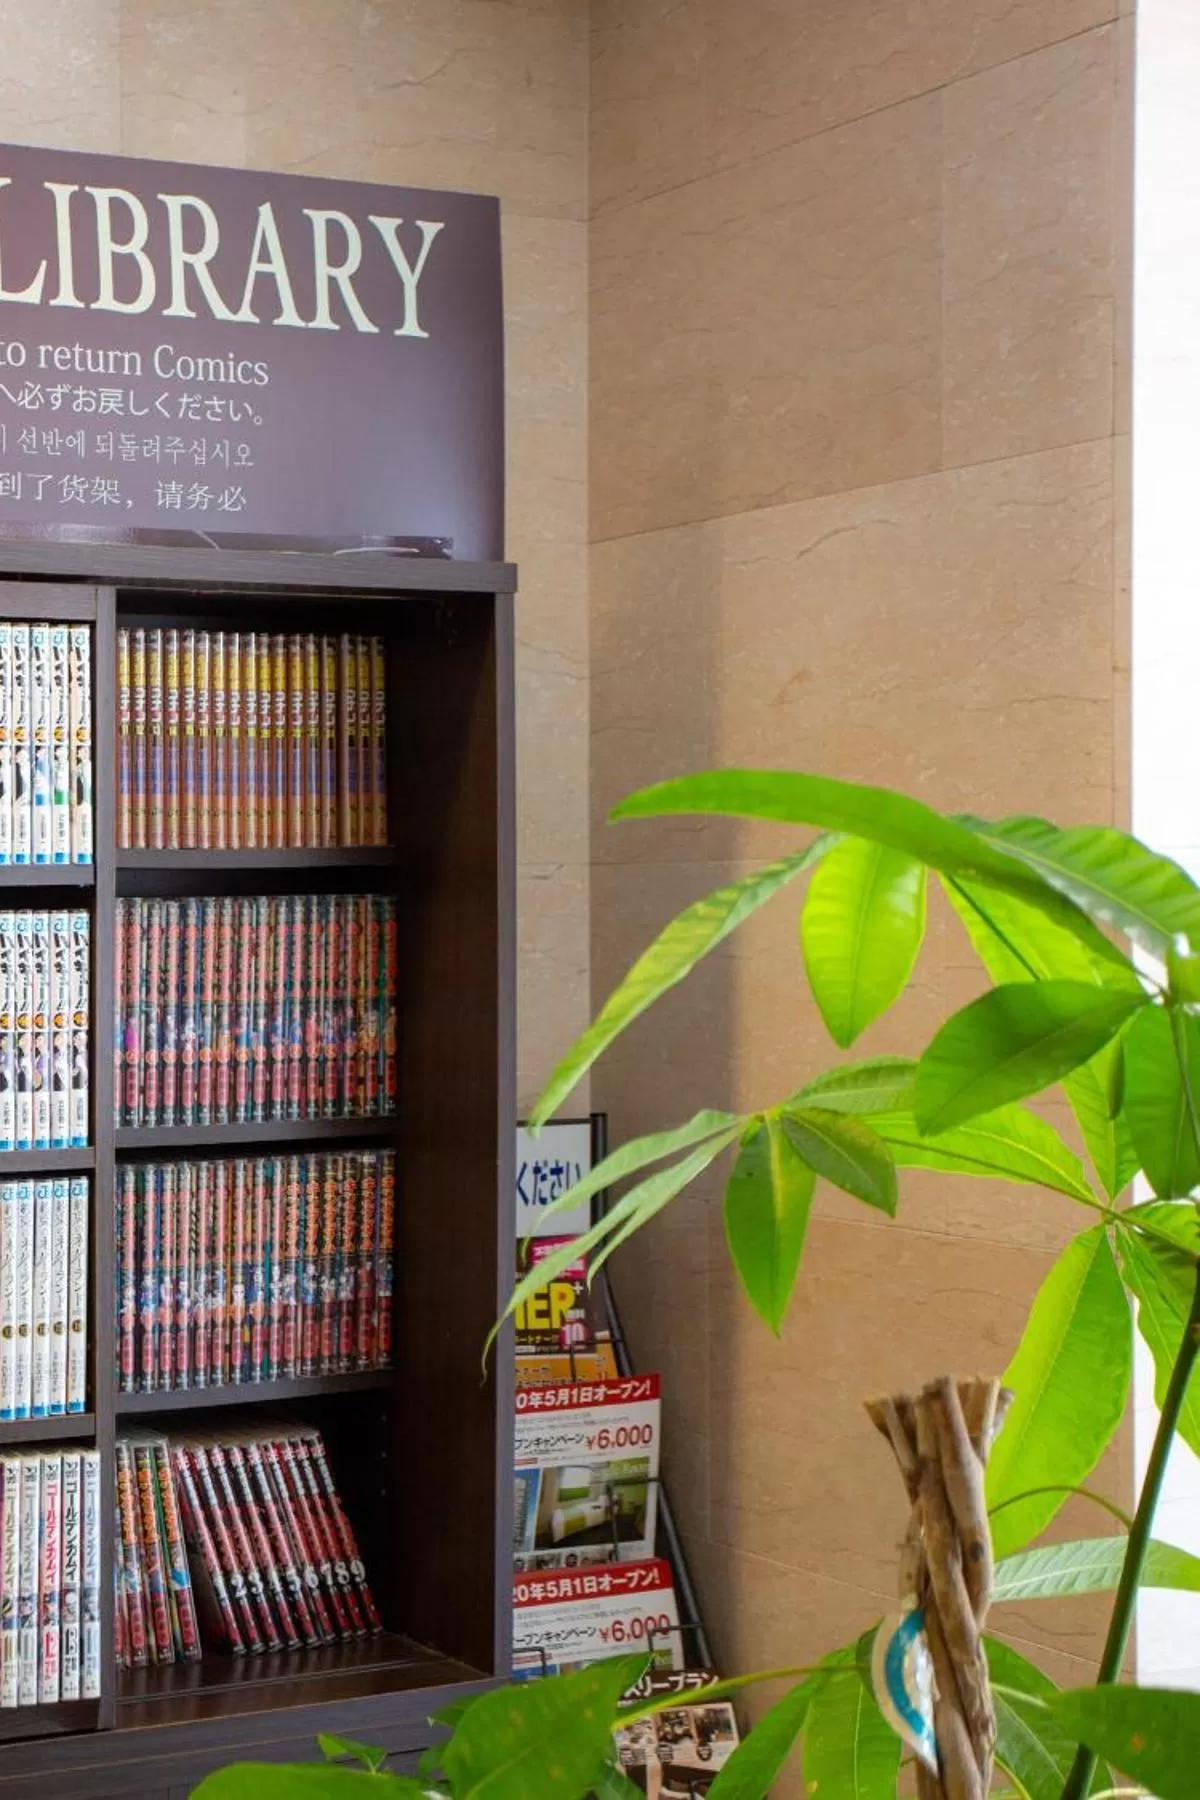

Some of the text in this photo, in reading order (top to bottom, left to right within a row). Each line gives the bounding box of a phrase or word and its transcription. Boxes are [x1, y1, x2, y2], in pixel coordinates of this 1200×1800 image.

[37, 341, 143, 376] return
[153, 344, 270, 386] Comics
[16, 425, 86, 458] 선반에
[95, 430, 255, 469] 되돌려주십시오
